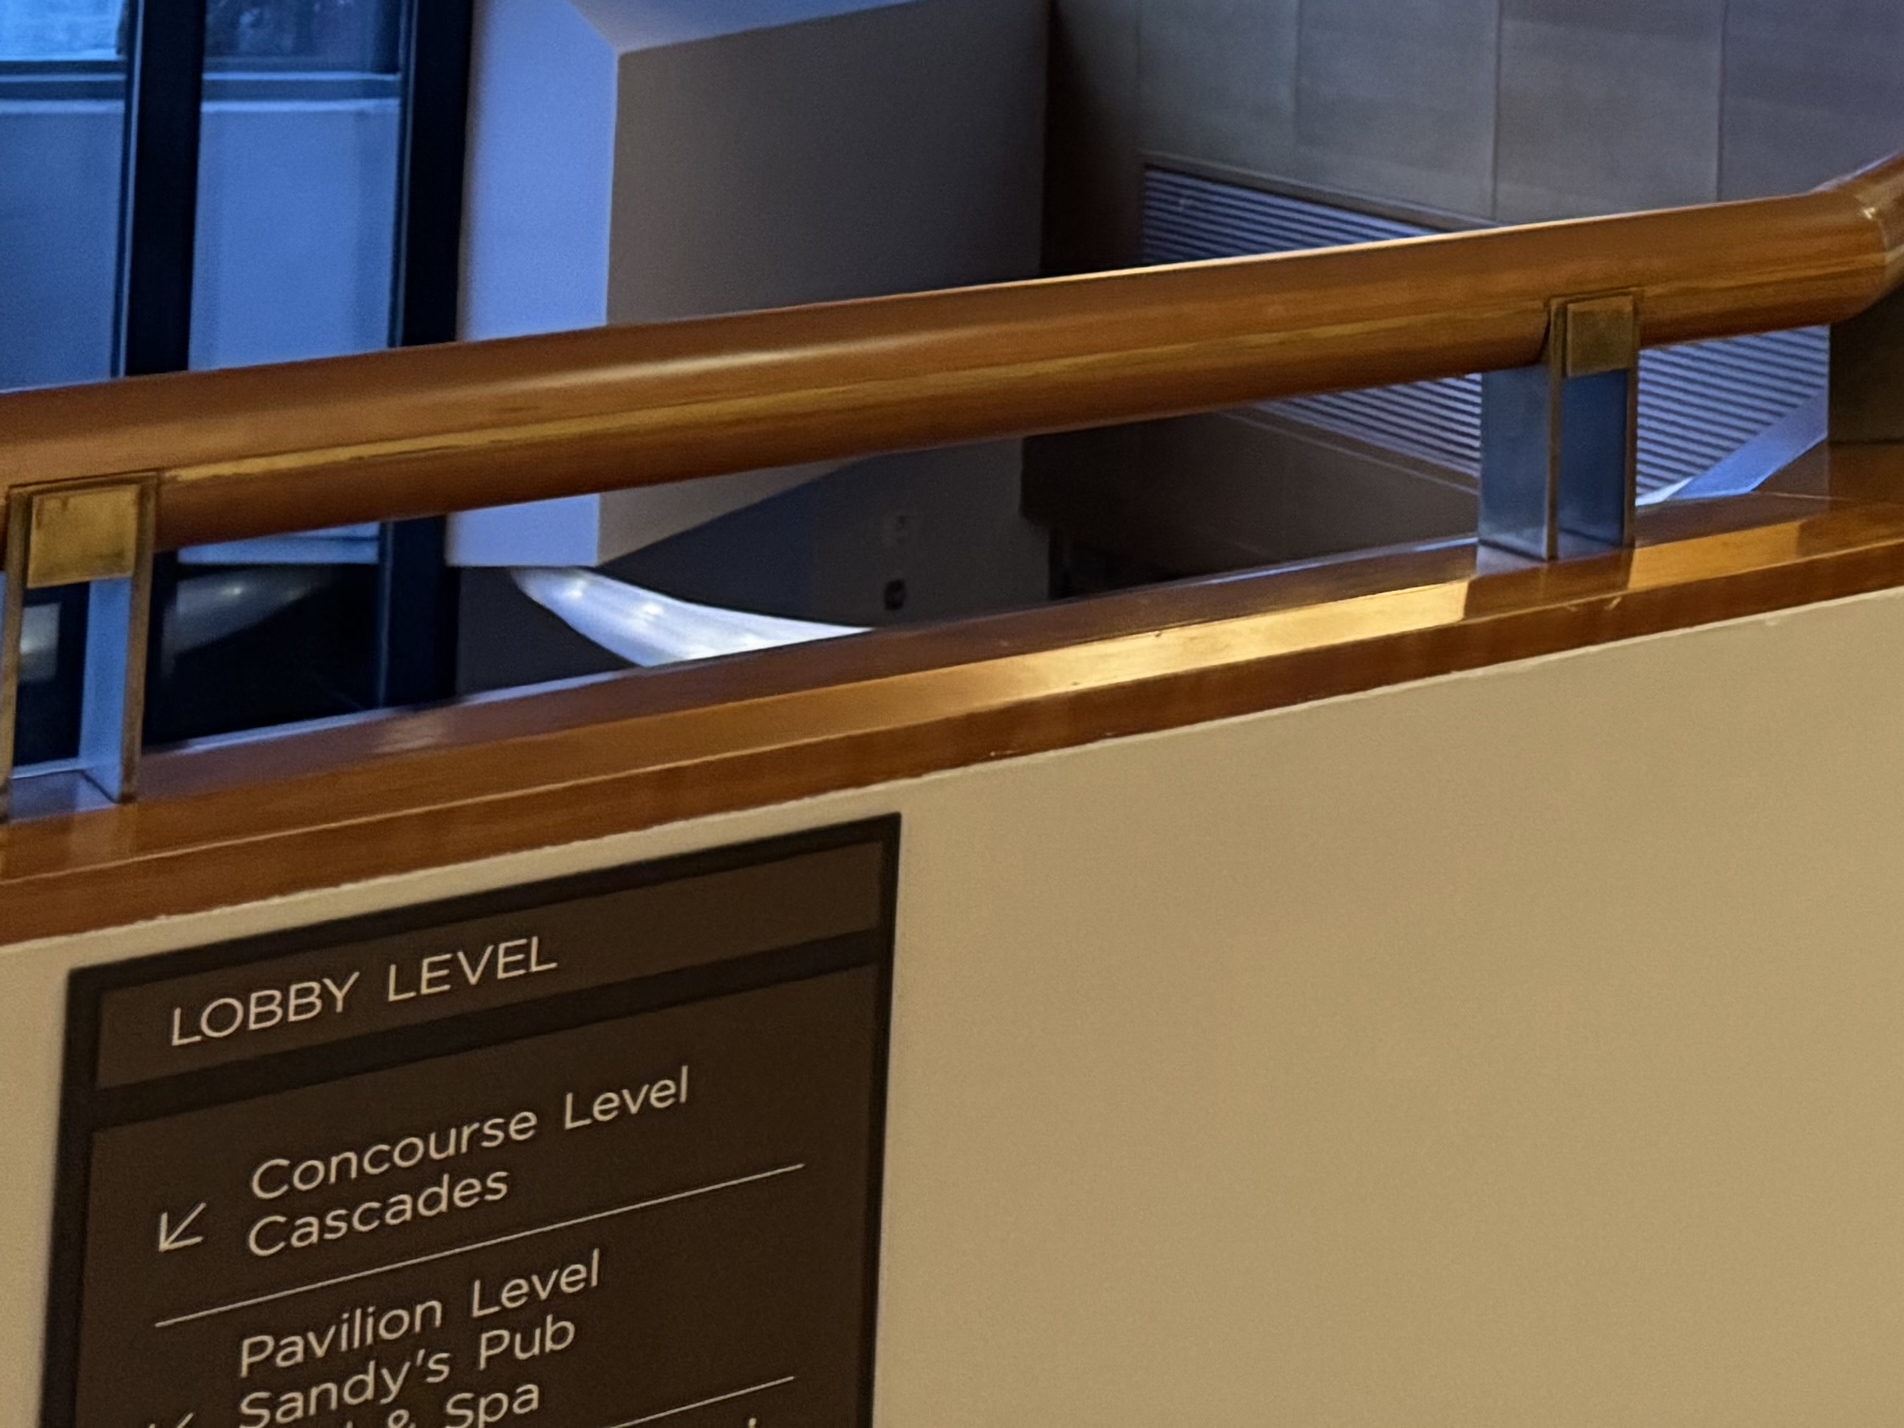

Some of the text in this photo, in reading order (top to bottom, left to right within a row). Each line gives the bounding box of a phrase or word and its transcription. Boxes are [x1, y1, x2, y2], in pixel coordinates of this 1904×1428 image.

[171, 936, 558, 1047] LOBBY LEVEL
[251, 1065, 689, 1200] Concourse Level
[248, 1171, 509, 1257] Cascades
[240, 1248, 600, 1378] Pavilion Level
[238, 1314, 575, 1428] Sandy's Pub
[445, 1383, 539, 1428] Spa
